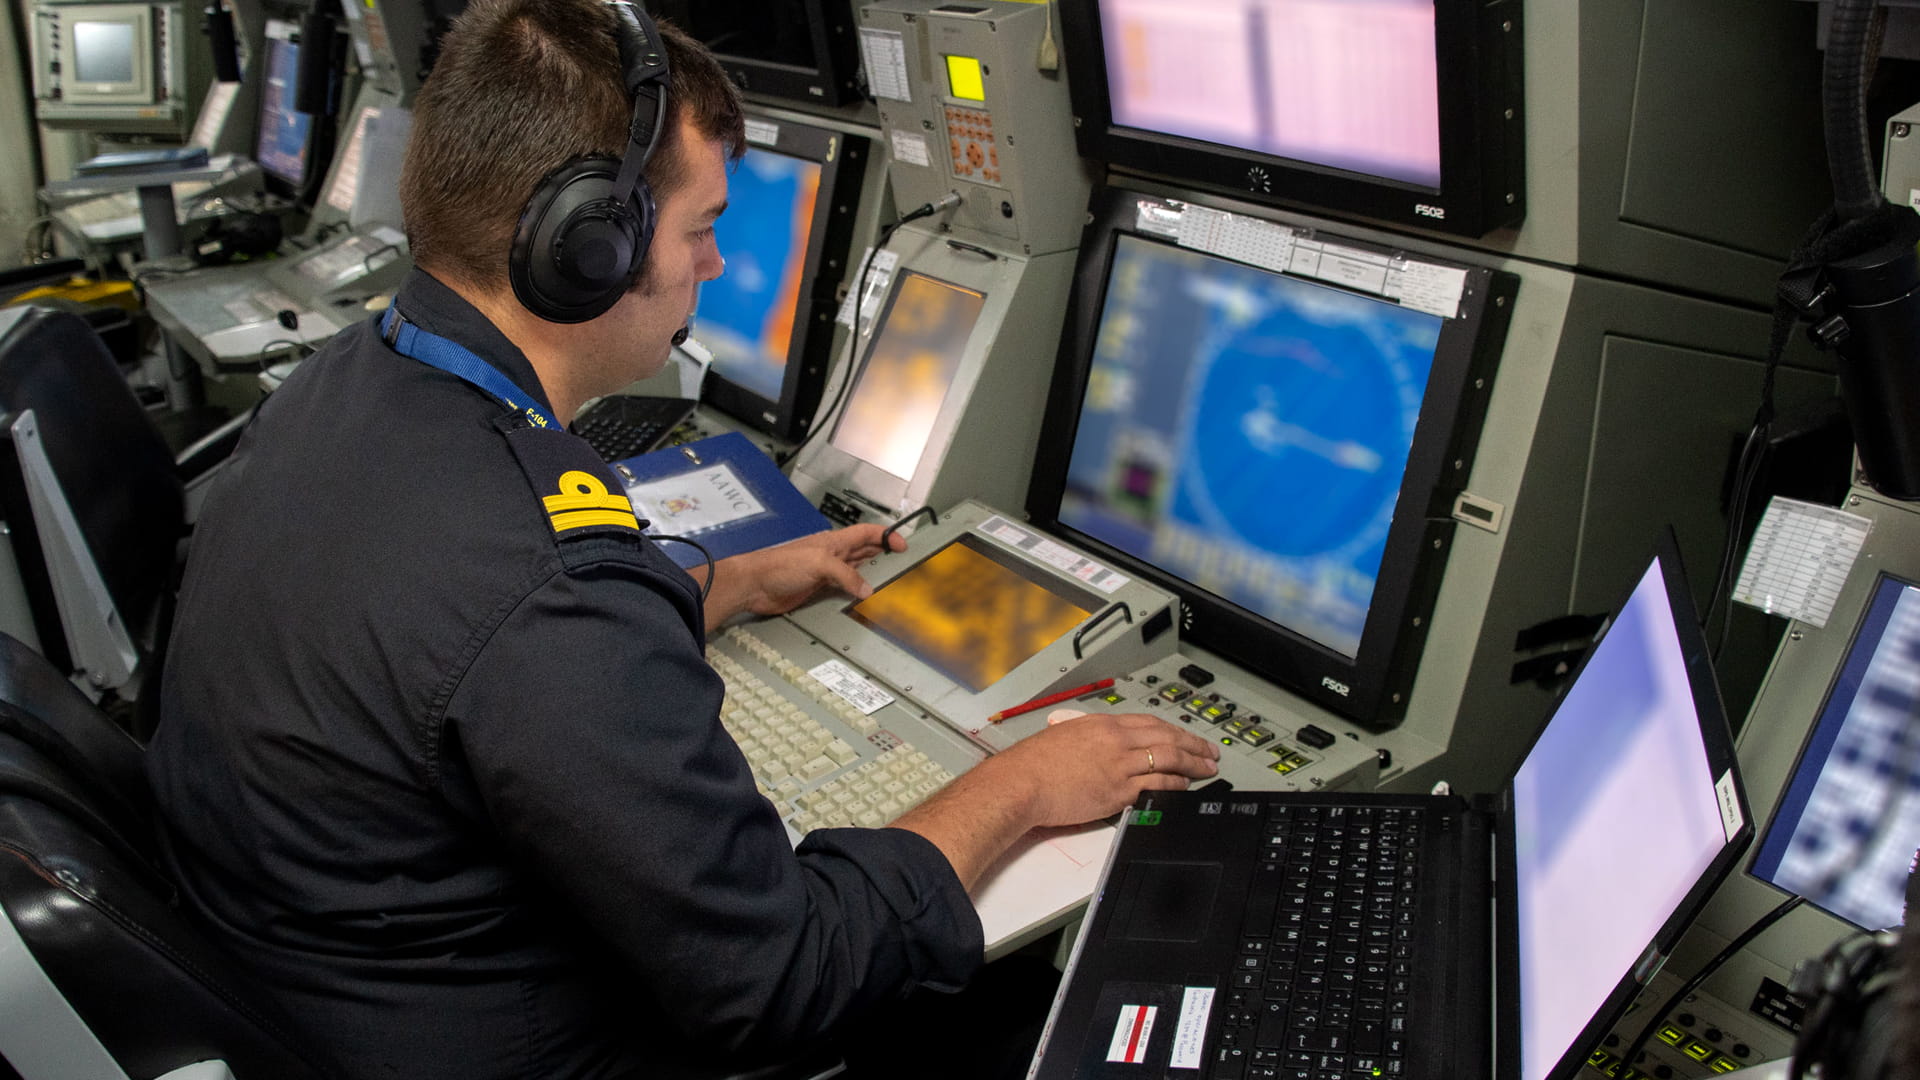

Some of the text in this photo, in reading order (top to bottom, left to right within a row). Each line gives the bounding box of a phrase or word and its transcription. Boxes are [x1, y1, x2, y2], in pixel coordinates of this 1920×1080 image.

[826, 136, 837, 162] 3
[526, 408, 548, 428] F-104
[704, 473, 752, 511] AAWC
